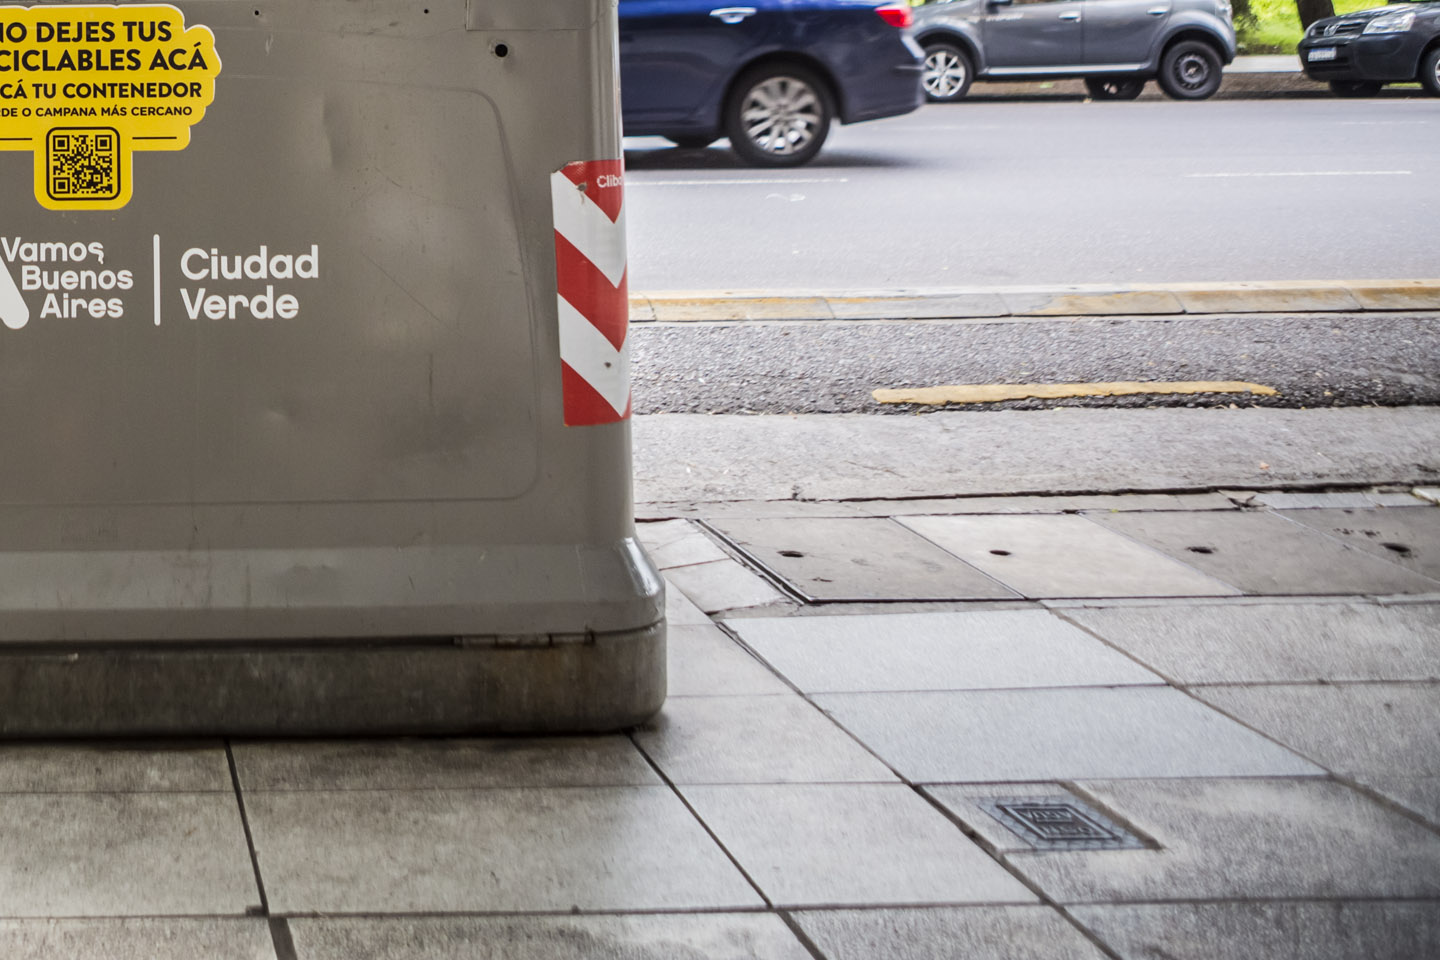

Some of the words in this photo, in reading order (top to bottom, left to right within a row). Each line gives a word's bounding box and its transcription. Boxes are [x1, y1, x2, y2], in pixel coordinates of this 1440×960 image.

[36, 21, 115, 43] DEJES
[122, 20, 172, 42] TUS
[149, 41, 208, 71] ACÁ
[31, 83, 57, 99] TU
[62, 82, 202, 99] CONTENEDOR
[21, 107, 32, 117] O
[35, 106, 97, 117] CAMPANA
[100, 104, 128, 117] MÁS
[130, 106, 193, 117] CERCANO
[1, 237, 104, 264] Vamos
[180, 245, 319, 281] Ciudad
[21, 265, 134, 291] Buenos
[40, 293, 124, 319] Aires
[180, 285, 300, 320] Verde
